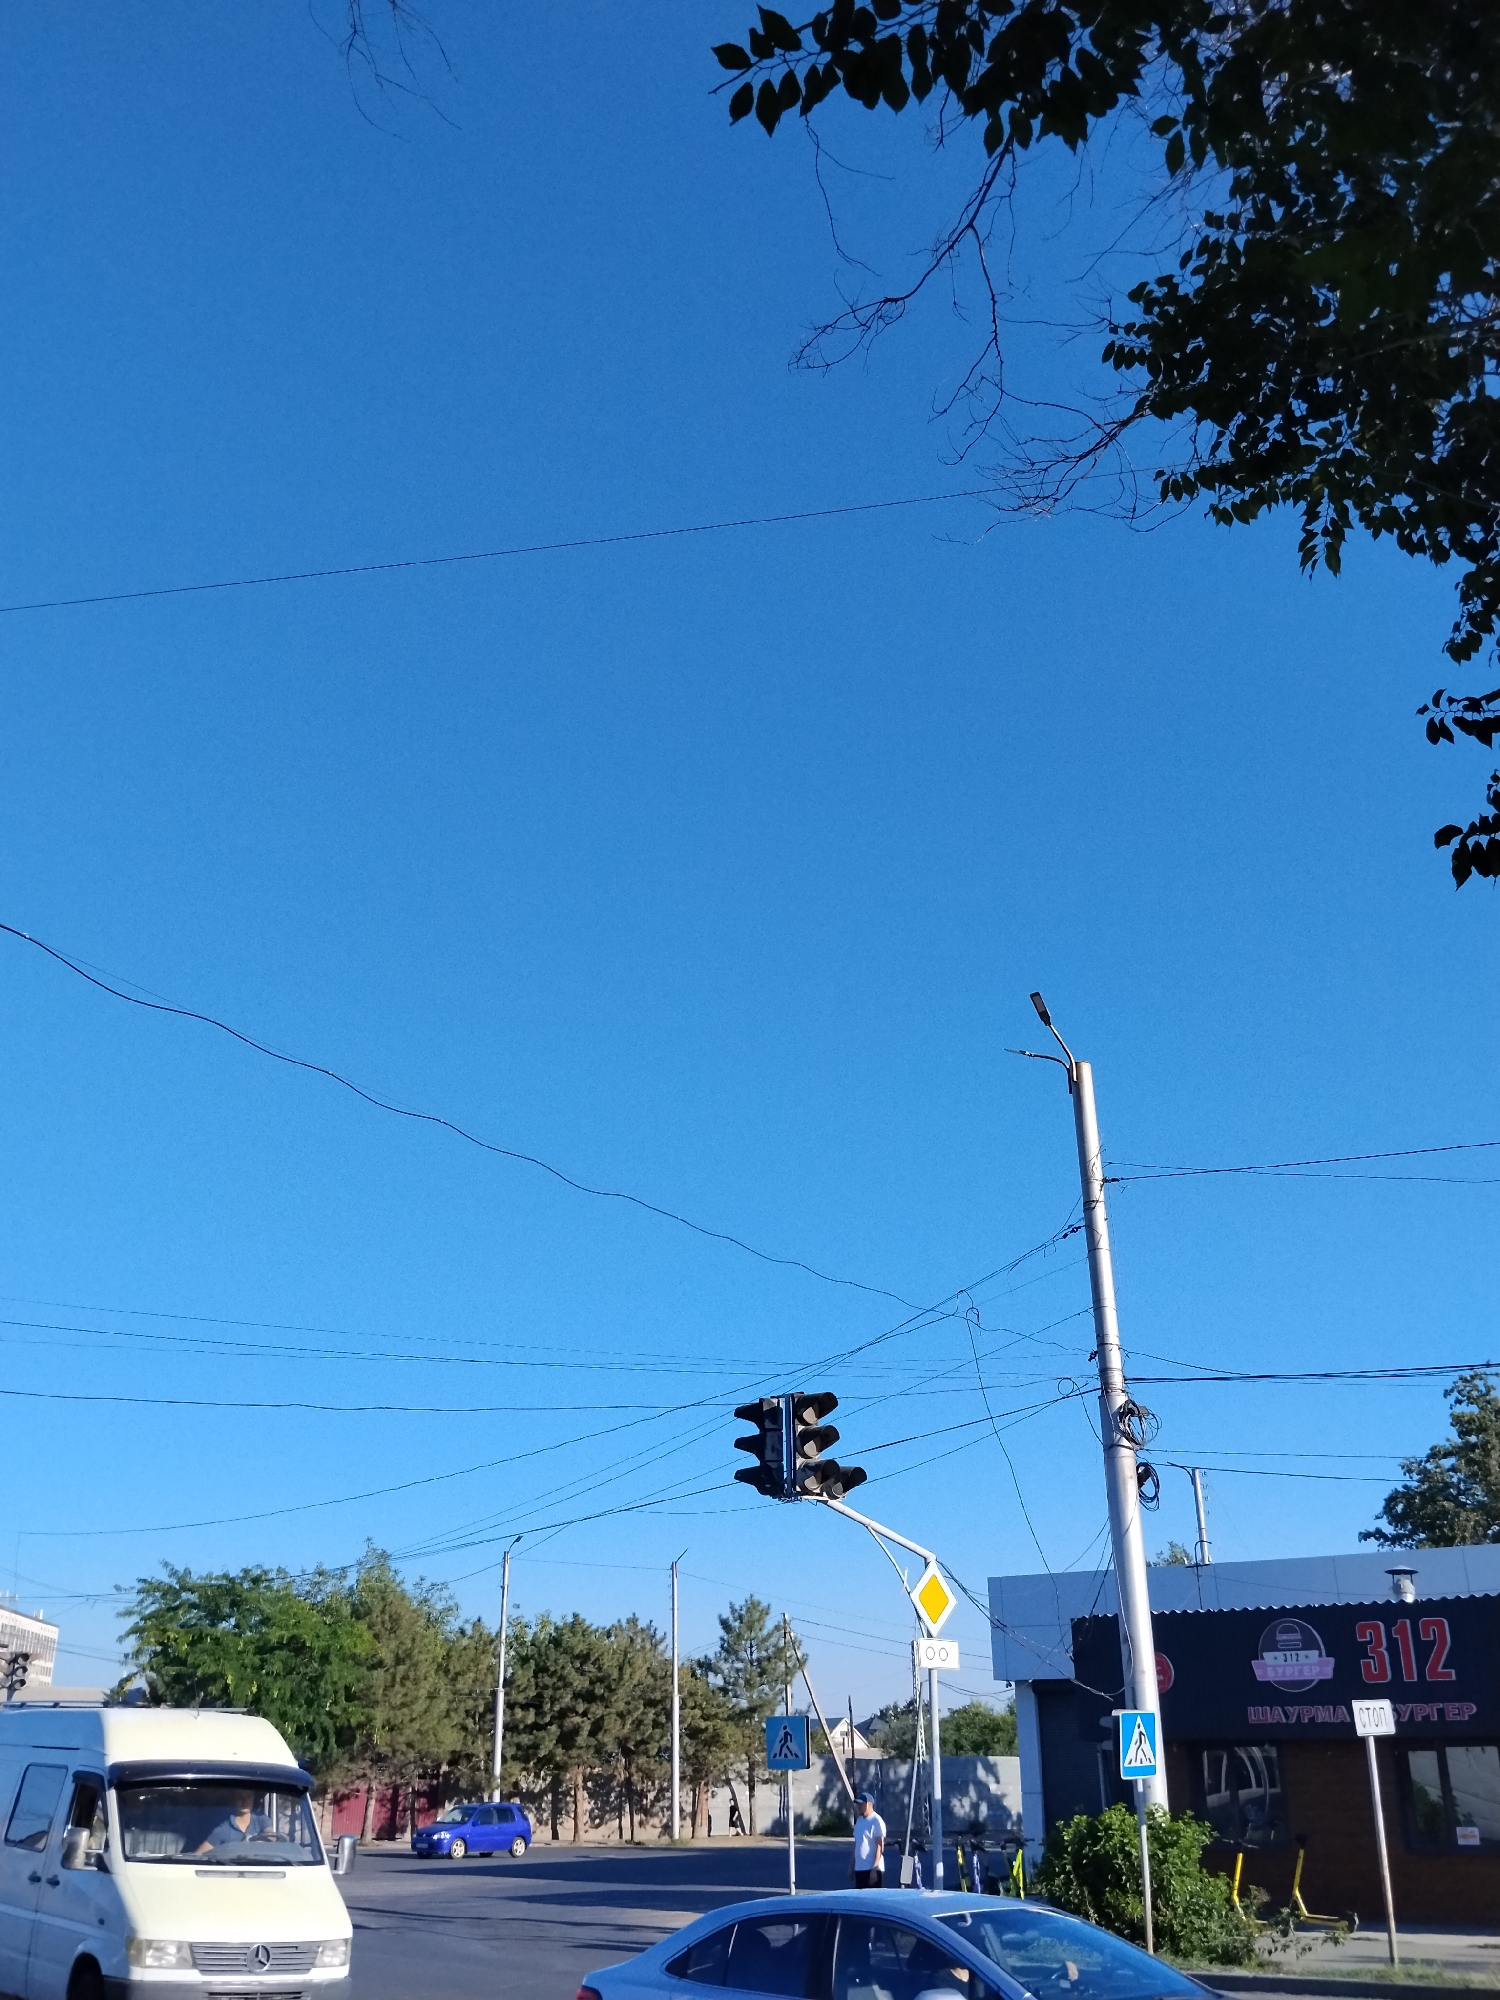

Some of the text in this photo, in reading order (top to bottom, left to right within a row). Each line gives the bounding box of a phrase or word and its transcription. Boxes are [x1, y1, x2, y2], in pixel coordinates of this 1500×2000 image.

[1282, 1652, 1300, 1663] 312
[1356, 1618, 1456, 1683] 312
[1266, 1665, 1320, 1677] БУРГЕР
[1248, 1705, 1351, 1723] ШАУРМА
[1359, 1707, 1388, 1728] СТОП
